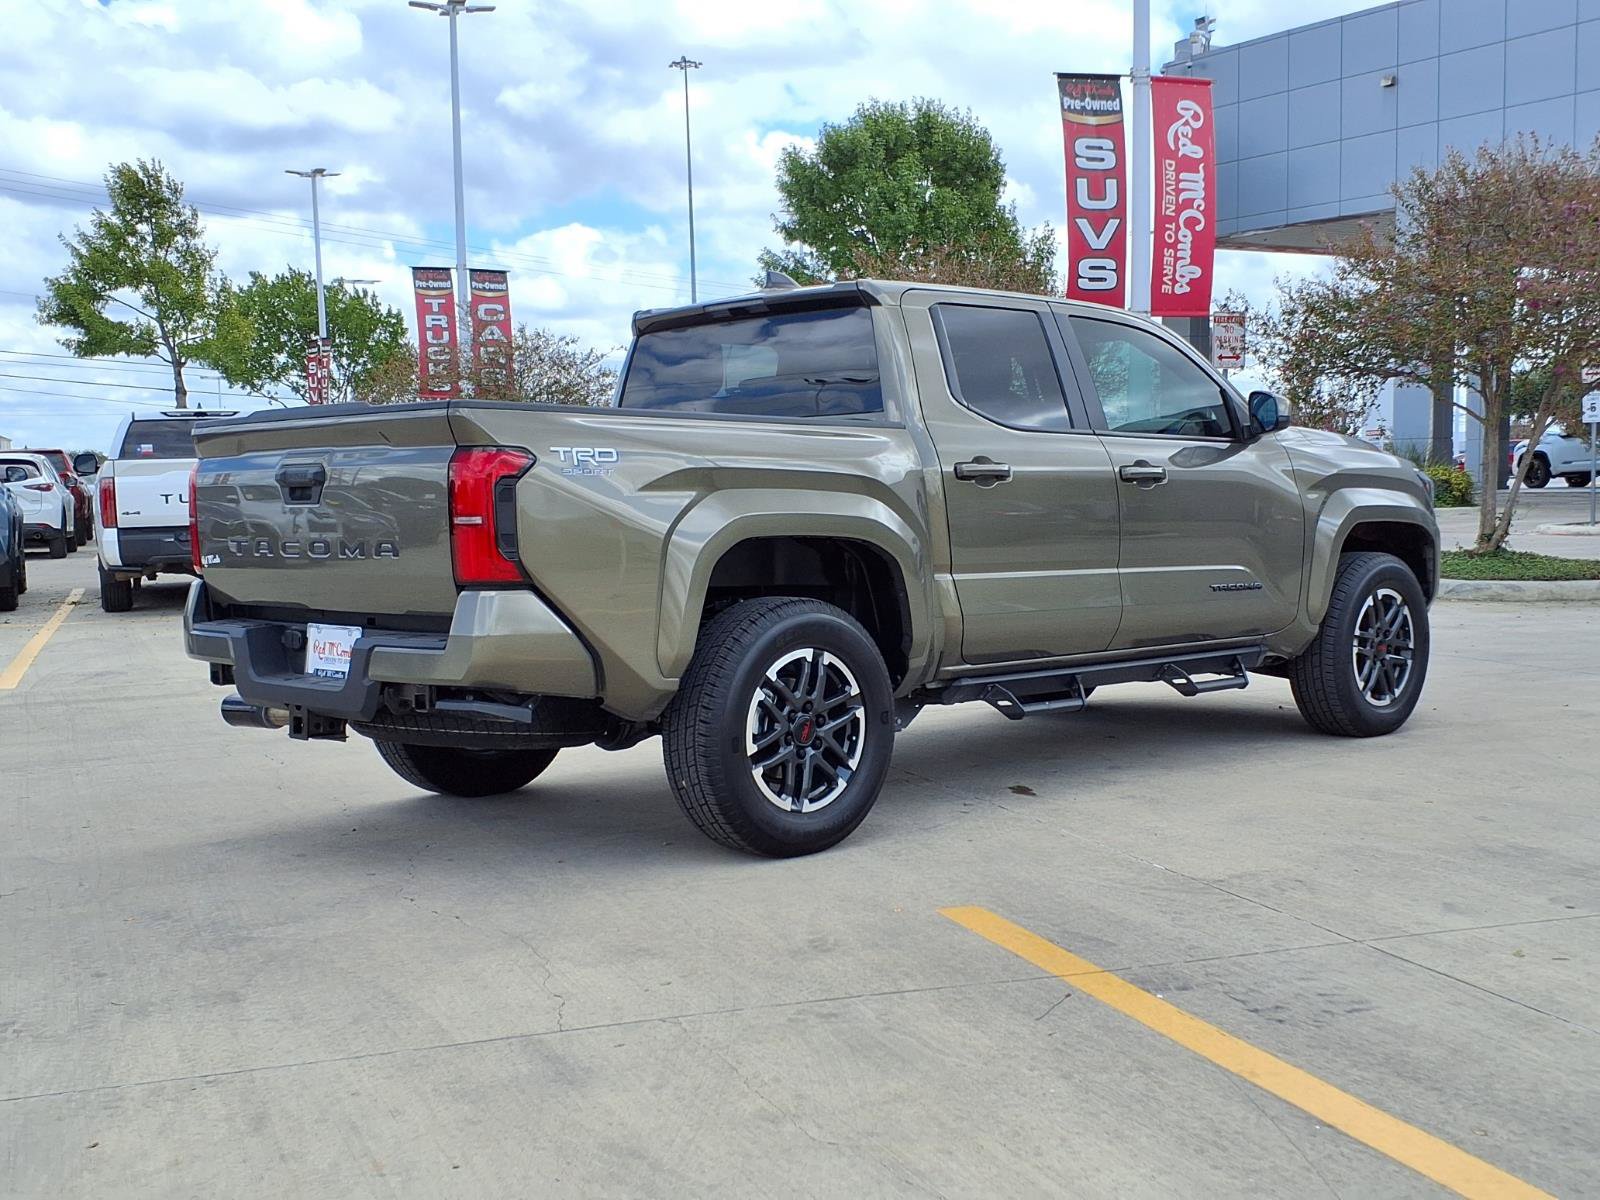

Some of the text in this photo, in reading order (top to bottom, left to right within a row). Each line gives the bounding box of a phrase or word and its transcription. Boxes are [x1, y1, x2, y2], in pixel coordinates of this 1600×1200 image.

[1063, 97, 1120, 111] Pre-Owned
[1167, 99, 1205, 295] Red McCombs
[1074, 137, 1121, 290] SUVS
[1162, 159, 1176, 294] DRIVEN TO SERVE
[415, 280, 451, 289] Pre-Owned
[471, 281, 507, 290] Pre-Owned
[550, 447, 618, 466] TRD
[228, 537, 400, 559] TACOMA
